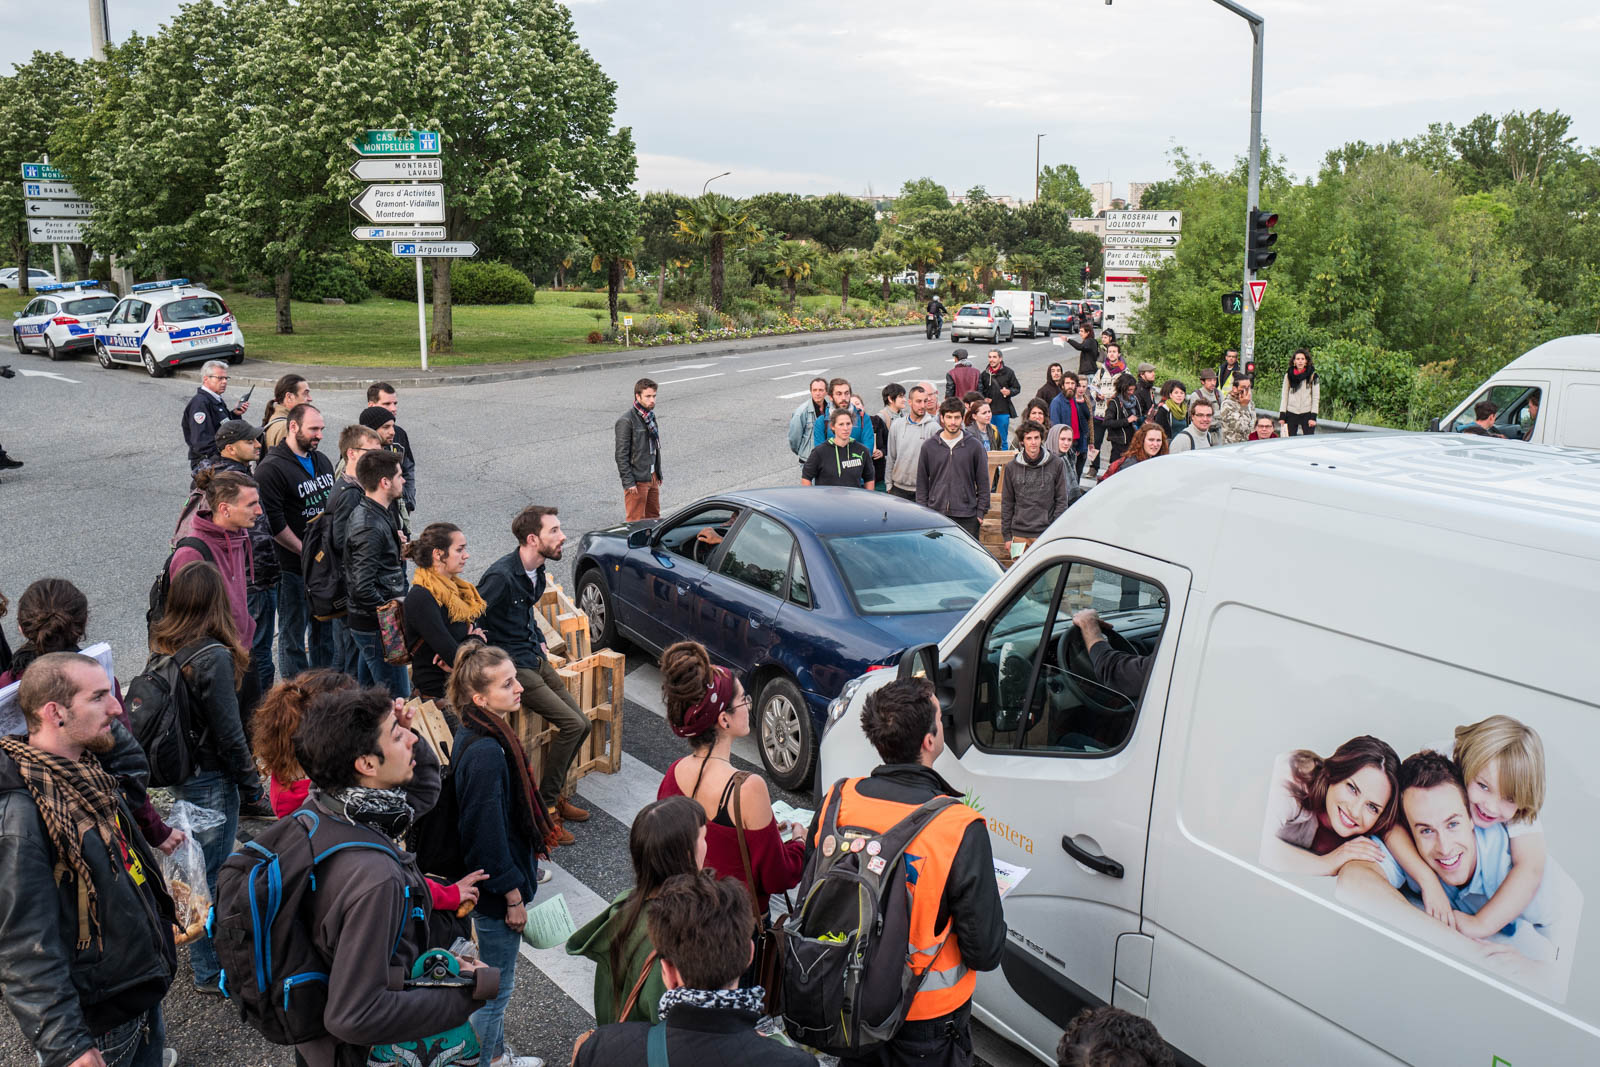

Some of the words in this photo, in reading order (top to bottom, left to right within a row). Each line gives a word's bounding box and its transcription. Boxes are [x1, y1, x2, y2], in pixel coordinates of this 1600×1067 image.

[364, 143, 414, 151] MONTPELLIER
[418, 246, 458, 254] Argoulets
[190, 328, 216, 336] POLICE
[114, 336, 138, 347] POLICE
[842, 459, 862, 469] PUMA
[989, 818, 1034, 854] astera
